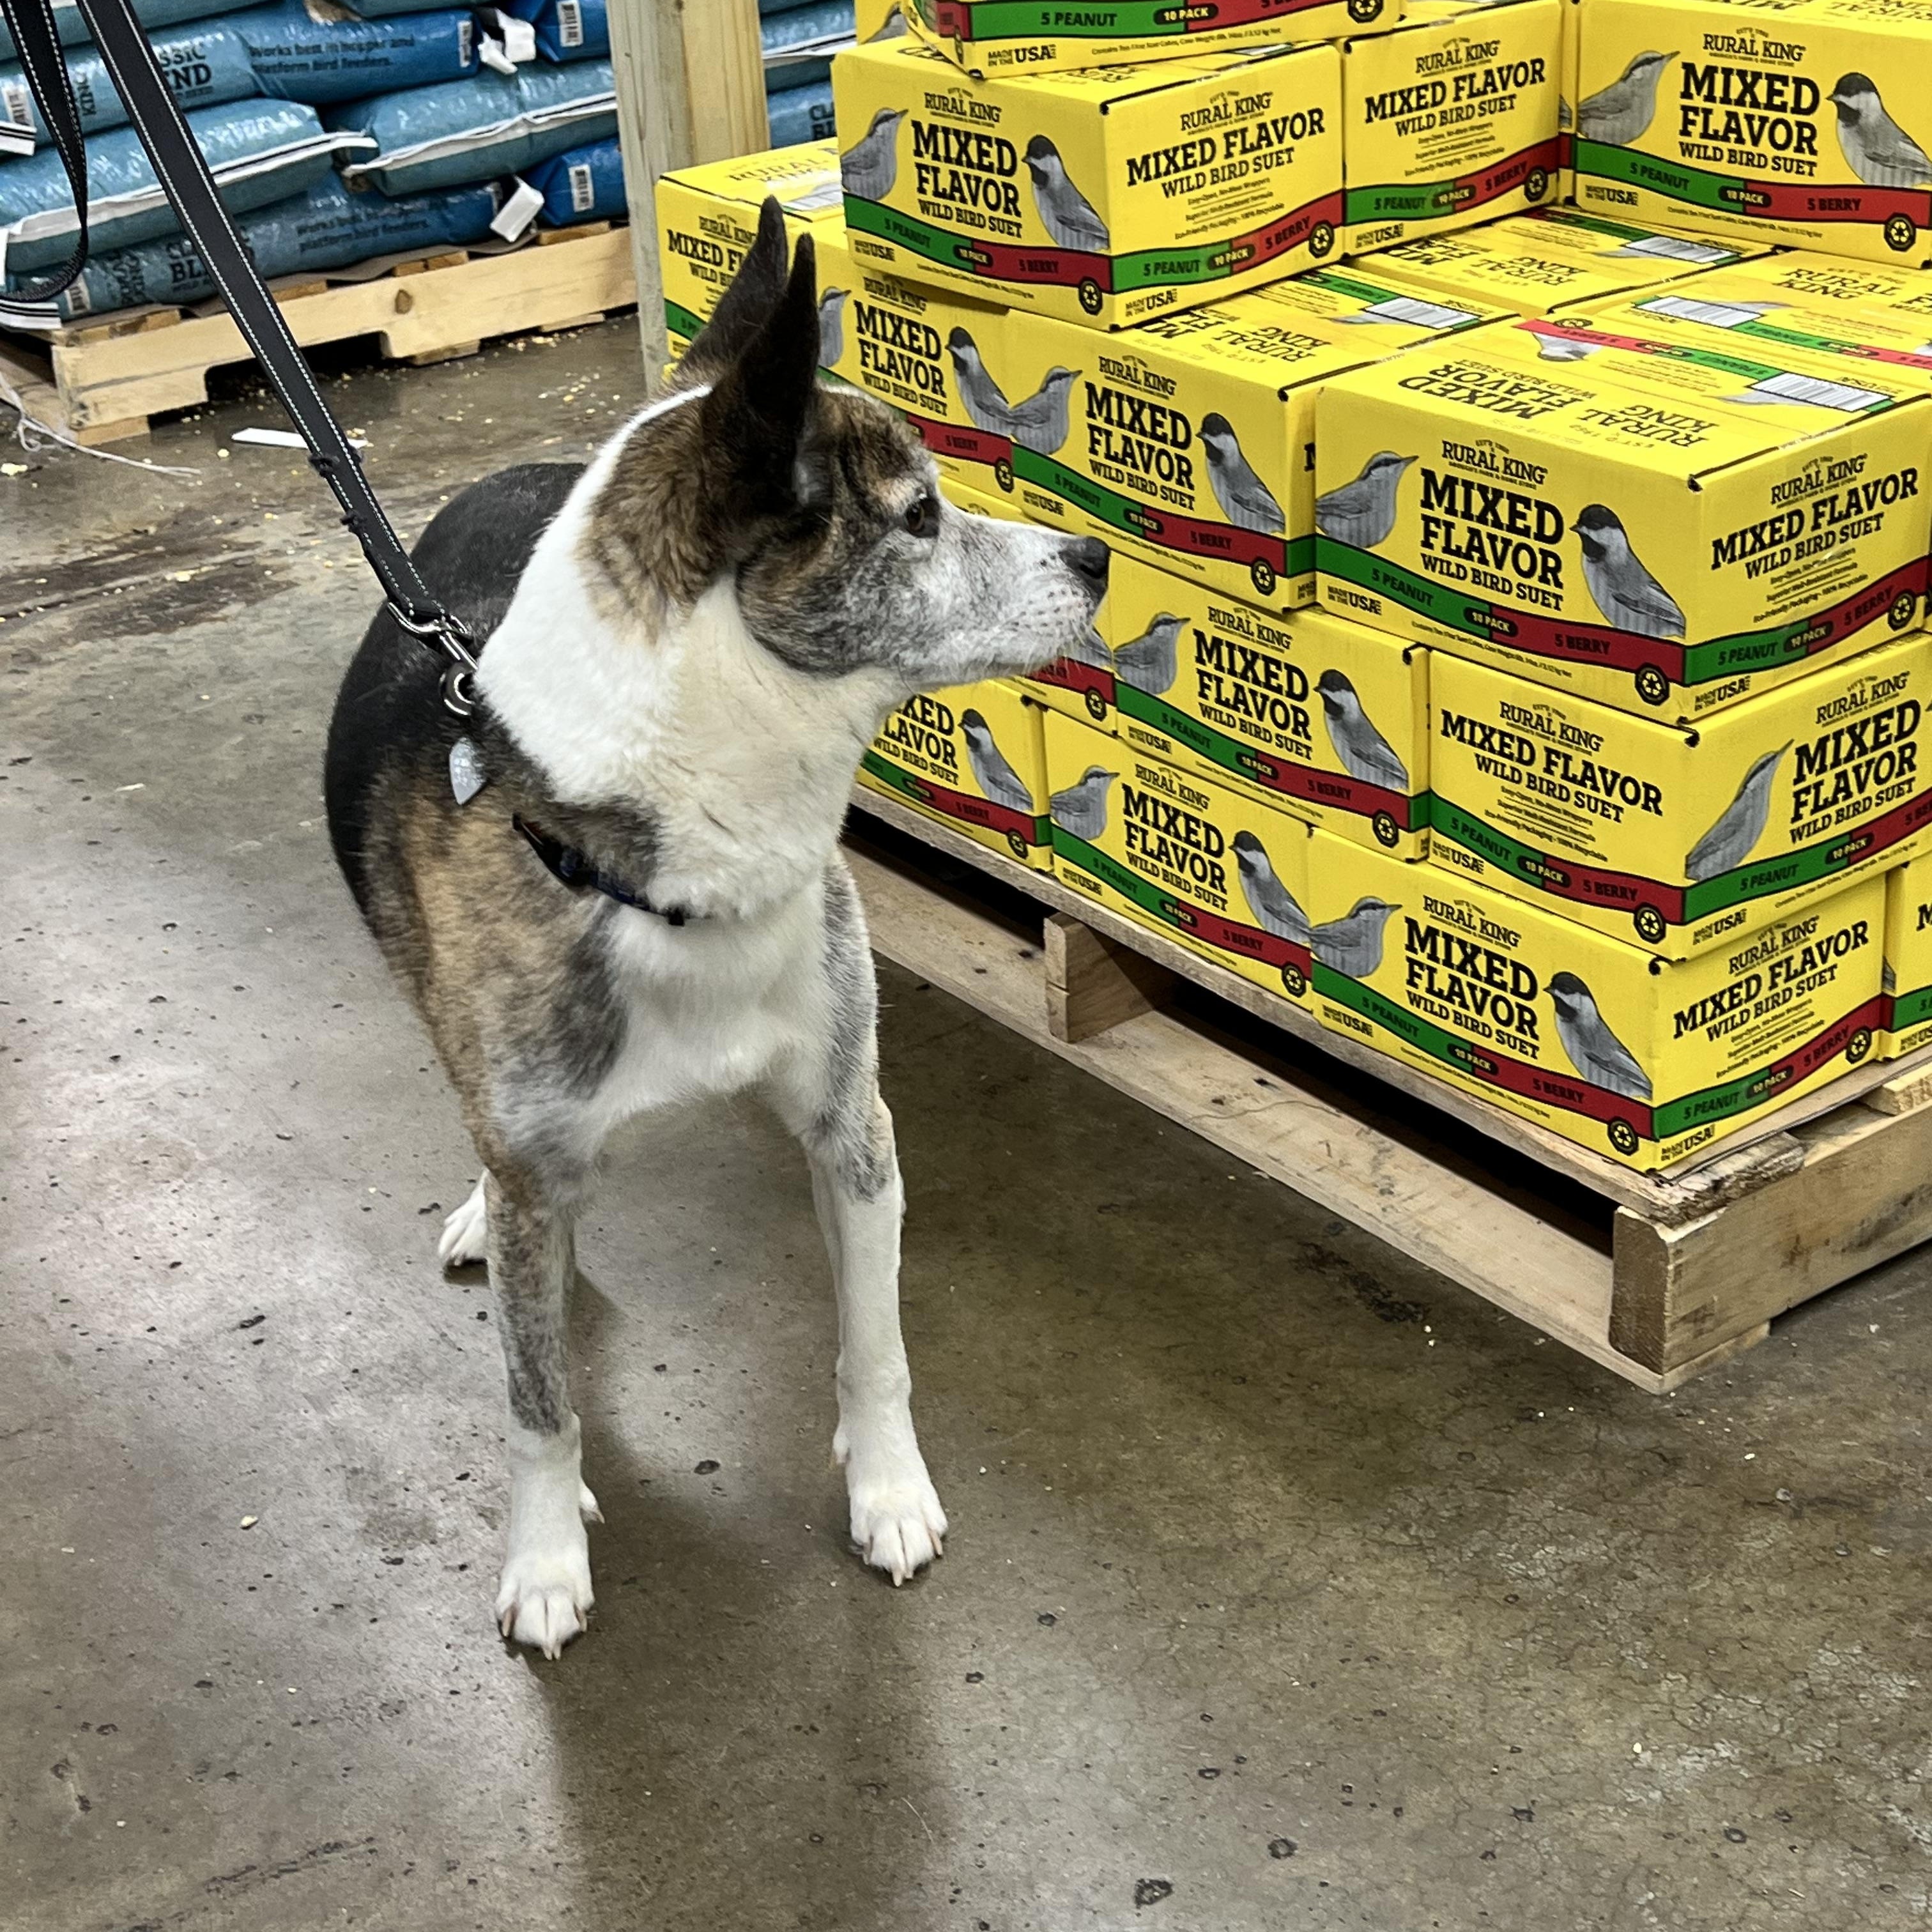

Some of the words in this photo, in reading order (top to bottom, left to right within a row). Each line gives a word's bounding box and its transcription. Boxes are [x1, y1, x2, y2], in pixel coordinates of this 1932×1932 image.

[1041, 12, 1050, 25] 5
[1055, 12, 1117, 27] PEANUT
[1180, 6, 1209, 19] PACK
[1015, 45, 1051, 63] USA
[1415, 48, 1462, 73] RURAL
[1465, 40, 1499, 62] KING
[1702, 33, 1758, 56] RURAL
[1762, 40, 1805, 61] KING
[924, 91, 967, 116] RURAL
[969, 100, 1001, 123] KING
[1179, 102, 1232, 131] RURAL
[1234, 91, 1271, 116] KING
[1365, 80, 1446, 123] MIXED
[1452, 57, 1545, 102] FLAVOR
[1395, 113, 1436, 137] WILD
[1438, 103, 1475, 126] BIRD
[1477, 93, 1517, 117] SUET
[1680, 61, 1820, 116] MIXED
[910, 119, 1017, 177] MIXED
[1126, 137, 1216, 187] MIXED
[1223, 107, 1324, 159] FLAVOR
[1678, 104, 1818, 156] FLAVOR
[1161, 172, 1206, 198] WILD
[1209, 160, 1249, 185] BIRD
[1252, 146, 1294, 173] SUET
[1678, 141, 1724, 162] WILD
[1726, 148, 1768, 168] BIRD
[1771, 155, 1817, 176] SUET
[914, 162, 1022, 218] FLAVOR
[917, 198, 953, 220] WILD
[954, 206, 986, 229] BIRD
[988, 215, 1022, 238] SUET
[1276, 215, 1310, 245] BERRY
[667, 229, 723, 266] MIXED
[1153, 257, 1202, 276] PEANUT
[1225, 247, 1248, 264] PACK
[1146, 289, 1172, 312] USA
[1772, 280, 1865, 300] KING
[1781, 268, 1902, 296] RURAL
[853, 300, 941, 361] MIXED
[857, 337, 946, 398] FLAVOR
[1098, 355, 1142, 385] RURAL
[1142, 370, 1176, 395] KING
[1429, 364, 1583, 408] FLAVOR
[1084, 381, 1192, 450] MIXED
[1398, 376, 1556, 419] MIXED
[1619, 405, 1720, 433] KING
[1577, 409, 1709, 447] RURAL
[1087, 422, 1194, 491] FLAVOR
[1441, 440, 1499, 473] RURAL
[1501, 456, 1547, 484] KING
[1770, 469, 1823, 505] RURAL
[1826, 453, 1866, 484] KING
[1089, 458, 1124, 484] WILD
[1126, 471, 1158, 496] BIRD
[1160, 484, 1195, 511] SUET
[1420, 467, 1563, 544] MIXED
[1711, 509, 1804, 570] MIXED
[1811, 467, 1918, 532] FLAVOR
[1420, 513, 1563, 589] FLAVOR
[1745, 547, 1791, 579] WILD
[1793, 530, 1836, 560] BIRD
[1839, 512, 1884, 544] SUET
[1349, 592, 1375, 614] USA
[1382, 571, 1433, 607] PEANUT
[1420, 552, 1468, 580] WILD
[1470, 567, 1512, 595] BIRD
[1515, 582, 1563, 611] SUET
[1207, 606, 1254, 636] RURAL
[1256, 623, 1292, 649] KING
[1566, 633, 1610, 656] BERRY
[1192, 628, 1308, 702] MIXED
[896, 693, 954, 737] XED
[1195, 668, 1312, 741] FLAVOR
[1815, 689, 1868, 724] RURAL
[1870, 670, 1910, 702] KING
[882, 712, 957, 769] LAVOR
[1198, 702, 1236, 728] WILD
[1238, 717, 1272, 743] BIRD
[1275, 733, 1312, 760] SUET
[1499, 700, 1556, 736] RURAL
[1558, 721, 1602, 752] KING
[1793, 699, 1920, 786] MIXED
[1135, 763, 1176, 794] RURAL
[1177, 783, 1209, 809] KING
[1440, 709, 1535, 766] MIXED
[1542, 746, 1662, 816] FLAVOR
[1474, 753, 1522, 785] WILD
[1525, 771, 1570, 802] BIRD
[1573, 790, 1623, 823] SUET
[1790, 741, 1917, 824] FLAVOR
[1121, 783, 1224, 858] MIXED
[1789, 813, 1832, 844] WILD
[1834, 795, 1872, 825] BIRD
[1874, 776, 1915, 807] SUET
[1123, 818, 1227, 895] FLAVOR
[1126, 850, 1160, 877] WILD
[1161, 868, 1192, 893] BIRD
[1193, 884, 1228, 912] SUET
[1423, 894, 1476, 930] RURAL
[1478, 917, 1521, 947] KING
[1728, 935, 1779, 974] RURAL
[1781, 915, 1818, 948] KING
[1404, 916, 1537, 1001] MIXED
[1673, 973, 1761, 1039] MIXED
[1768, 920, 1868, 991] FLAVOR
[1405, 955, 1538, 1041] FLAVOR
[1405, 989, 1449, 1020] WILD
[1452, 1009, 1492, 1038] BIRD
[1495, 1029, 1539, 1059] SUET
[1706, 1008, 1750, 1041] WILD
[1753, 986, 1793, 1019] BIRD
[1795, 963, 1837, 997] SUET
